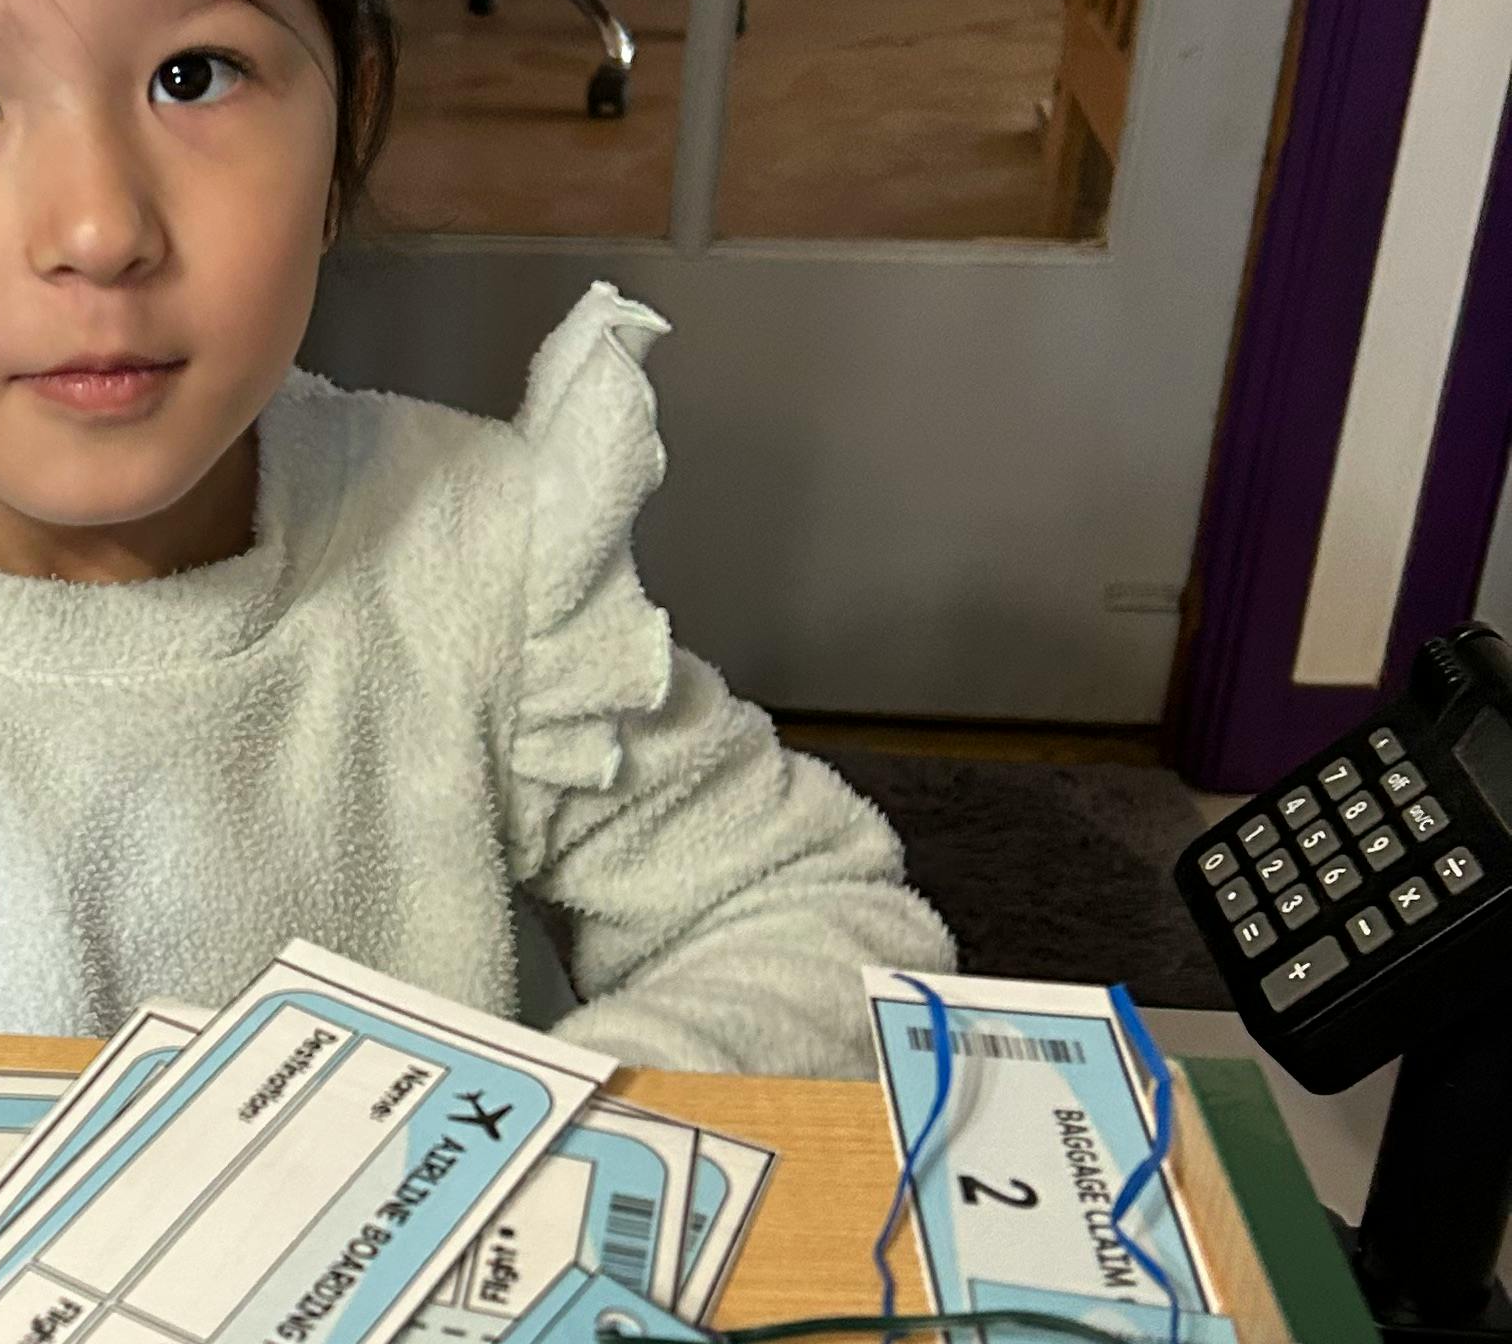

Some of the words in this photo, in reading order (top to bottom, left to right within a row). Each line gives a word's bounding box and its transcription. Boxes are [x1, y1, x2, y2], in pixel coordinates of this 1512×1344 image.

[377, 1133, 467, 1227] AIRLINE
[956, 1172, 1040, 1211] 2
[1052, 1107, 1113, 1204] BAGGAGE
[276, 1221, 393, 1344] BOARDING
